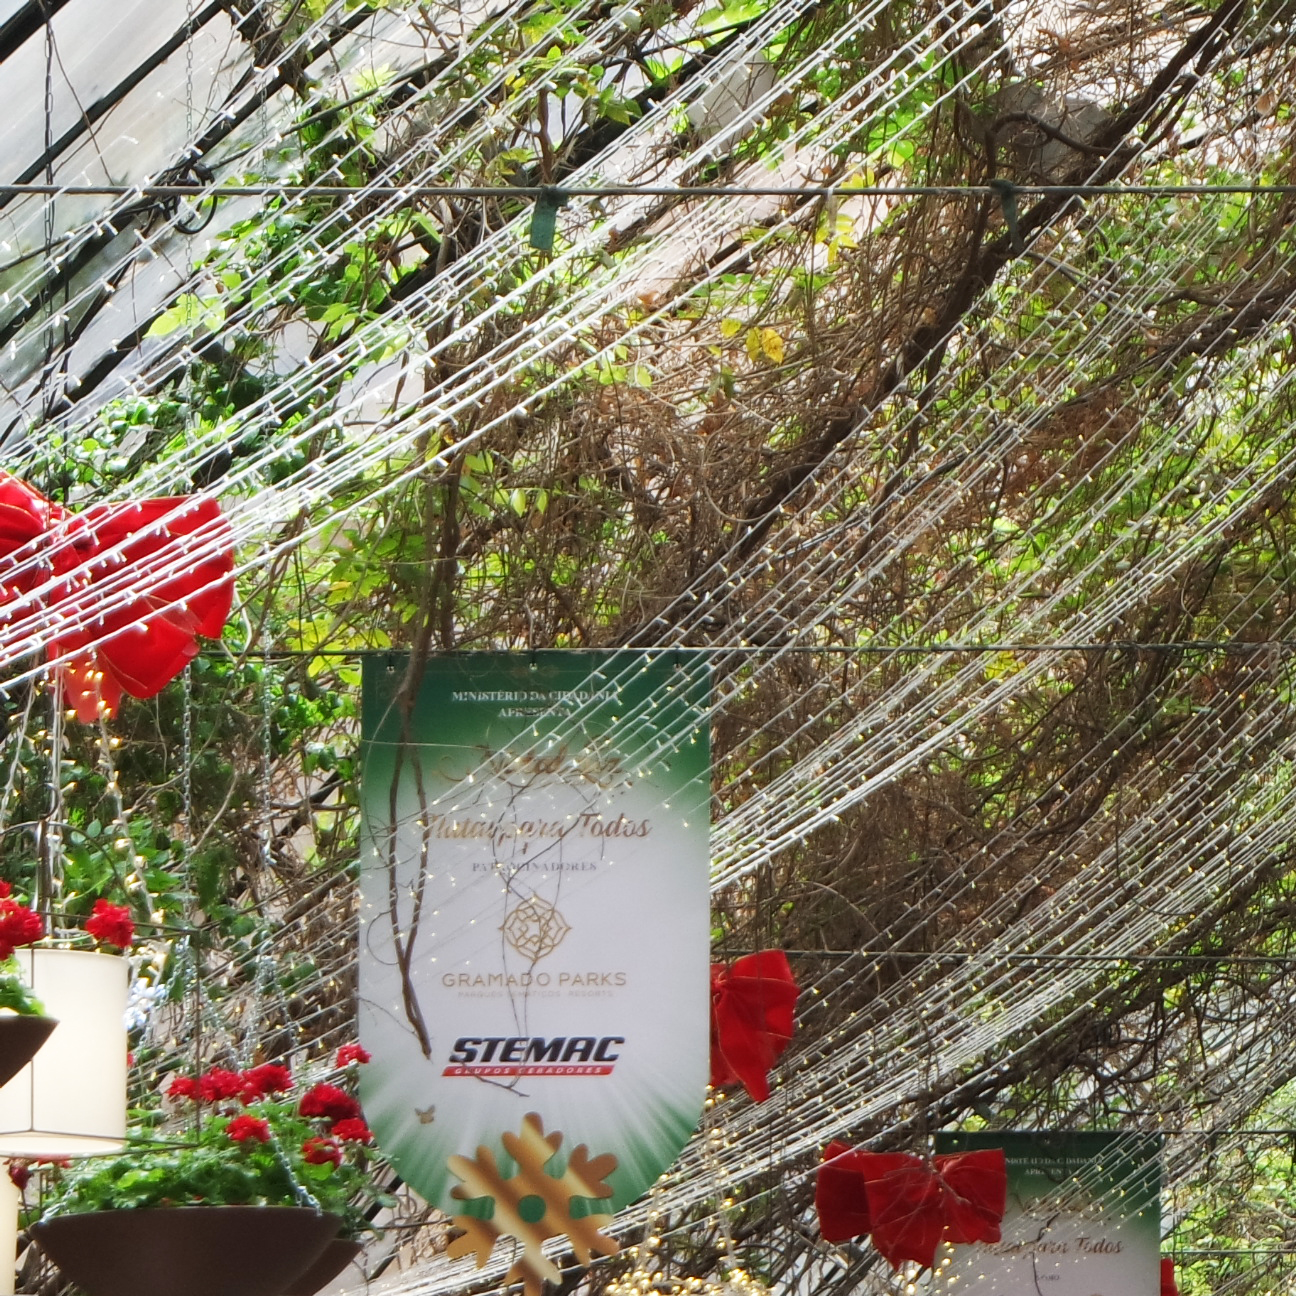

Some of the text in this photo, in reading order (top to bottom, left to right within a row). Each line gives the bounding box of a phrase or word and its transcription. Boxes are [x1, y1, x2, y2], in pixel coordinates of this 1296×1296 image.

[576, 811, 653, 838] Todos
[441, 971, 627, 988] GRAMADO PARKS
[449, 1036, 625, 1063] STEMAC
